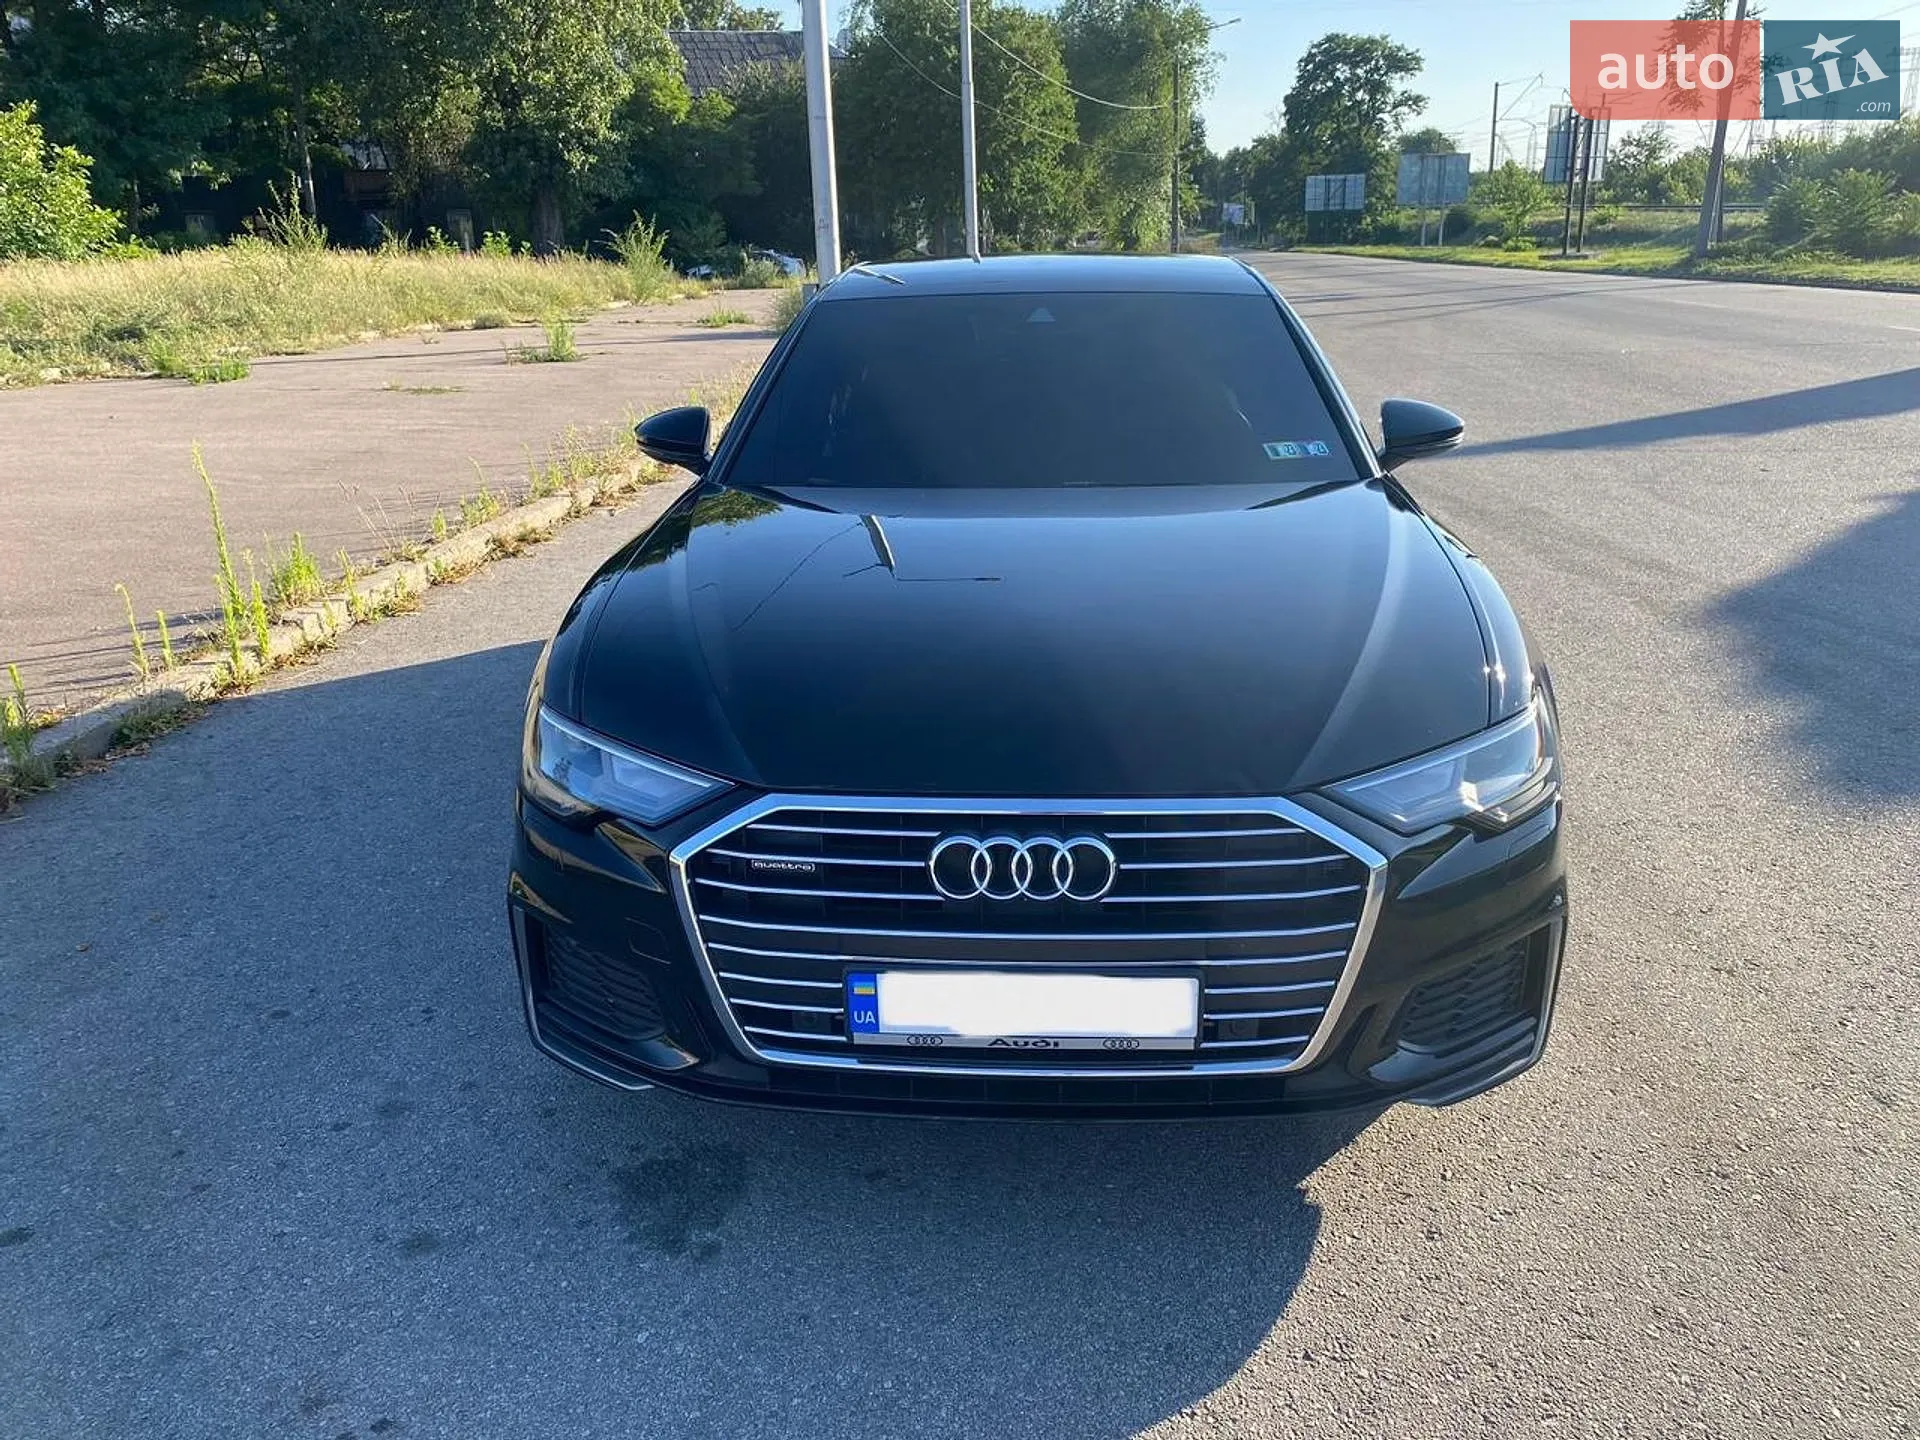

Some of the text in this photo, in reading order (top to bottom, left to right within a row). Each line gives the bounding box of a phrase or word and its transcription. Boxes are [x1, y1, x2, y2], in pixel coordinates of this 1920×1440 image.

[754, 862, 812, 871] quattro
[854, 1010, 876, 1024] UA
[987, 1038, 1059, 1048] Audi
